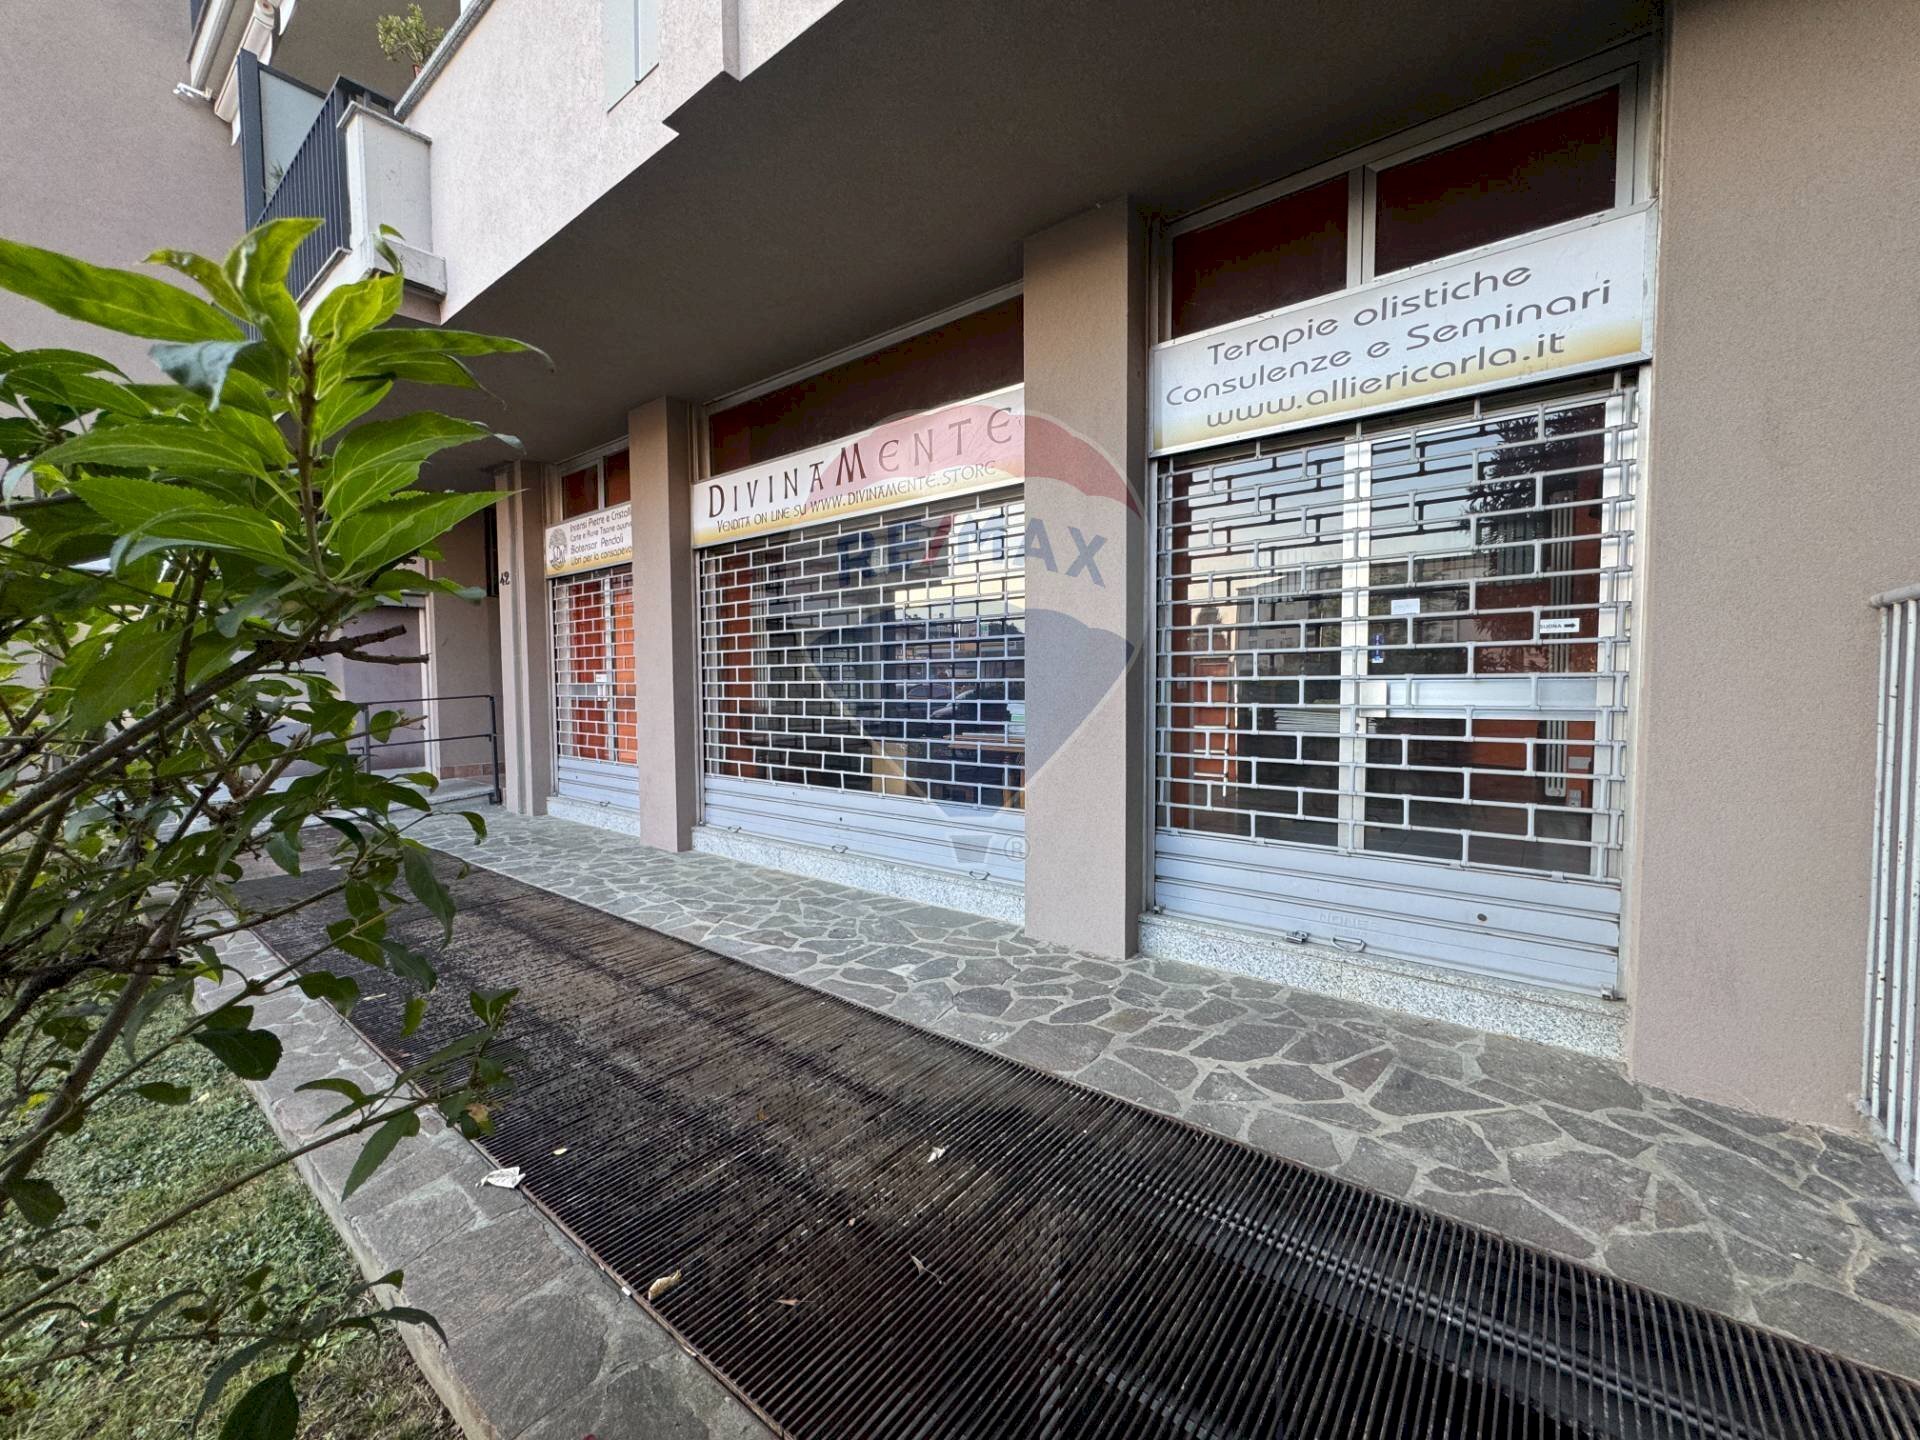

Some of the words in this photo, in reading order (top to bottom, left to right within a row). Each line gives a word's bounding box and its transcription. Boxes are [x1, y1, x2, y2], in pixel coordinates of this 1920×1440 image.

[1166, 347, 1352, 407] Consulenze
[1366, 337, 1390, 359] e
[1406, 279, 1611, 352] Seminari
[1207, 316, 1338, 366] Terapie
[1353, 266, 1531, 327] olistiche
[1206, 333, 1566, 428] www.alliericarla.it
[708, 407, 1013, 518] DIVINAMENTE
[600, 533, 624, 548] Pendoli
[754, 511, 767, 525] ON
[771, 507, 790, 522] LINE
[793, 503, 807, 518] SU
